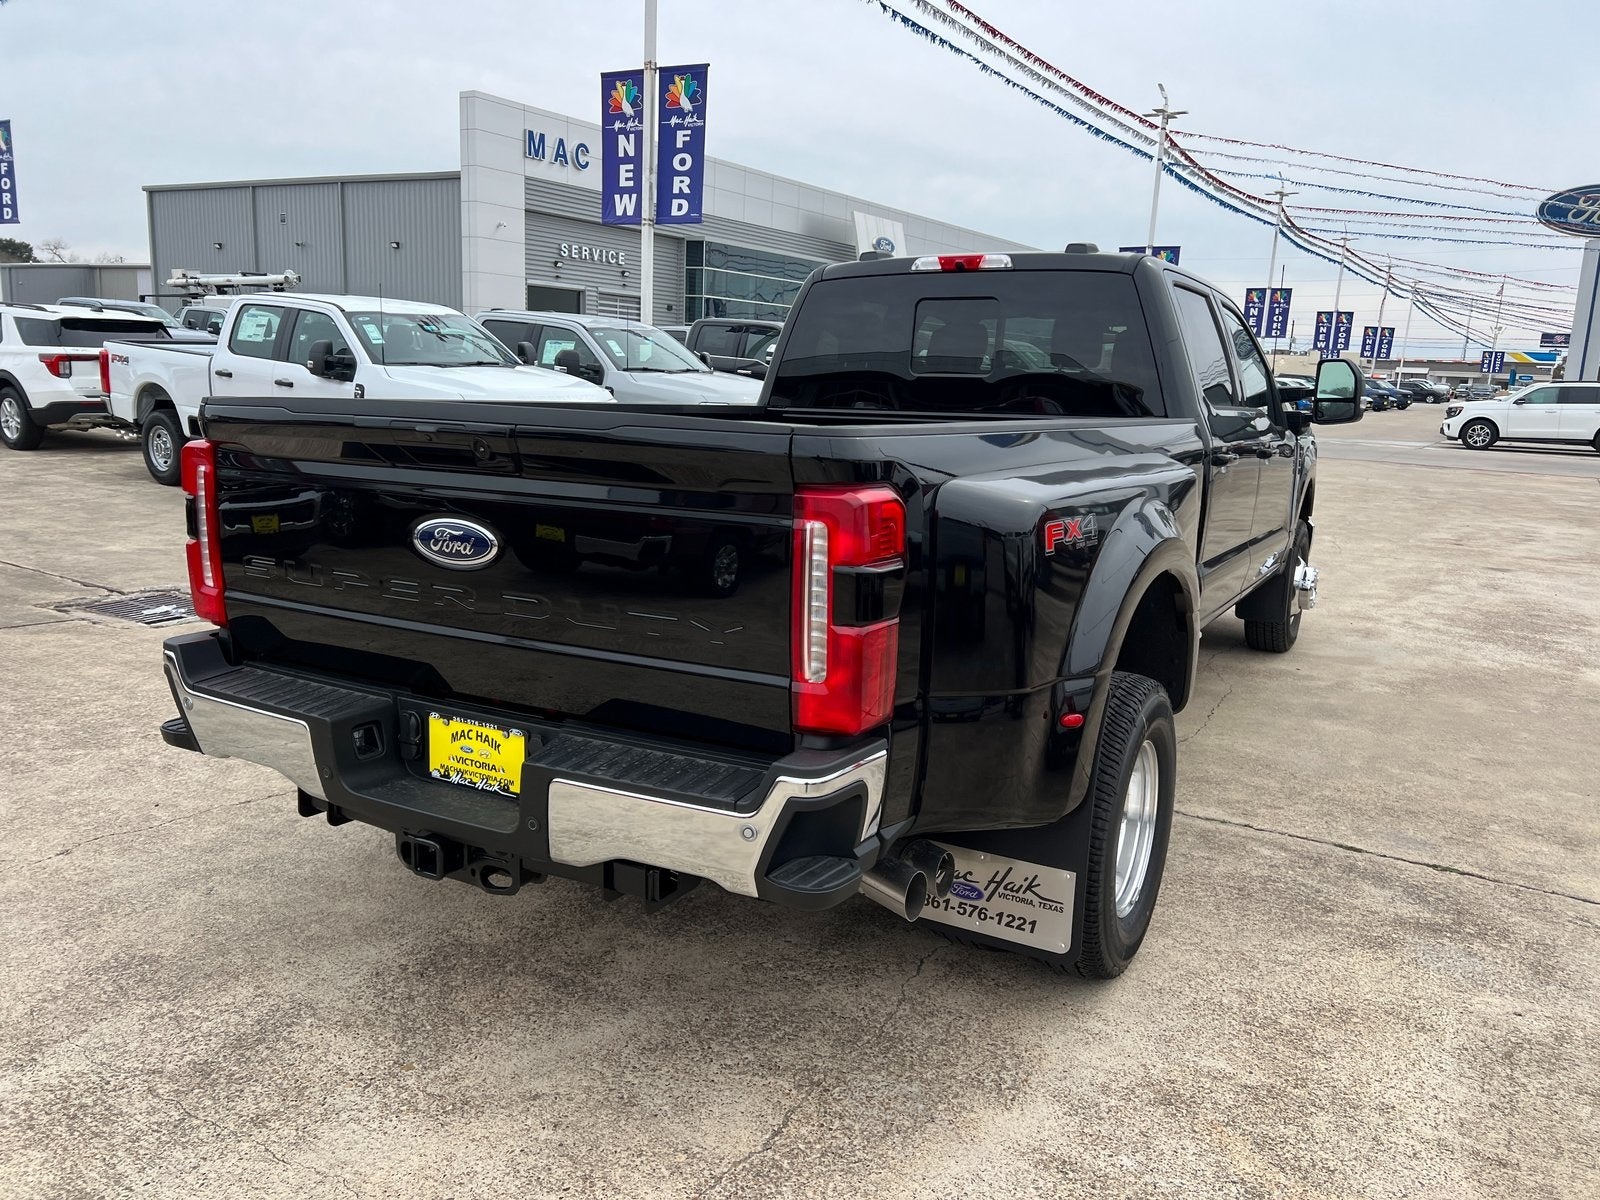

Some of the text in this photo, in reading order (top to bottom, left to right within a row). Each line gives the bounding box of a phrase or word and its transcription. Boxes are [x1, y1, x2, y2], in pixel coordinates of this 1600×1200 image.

[525, 129, 590, 170] MAC
[614, 134, 637, 216] NEW
[671, 130, 692, 217] FORD
[1, 163, 12, 219] FORD
[560, 243, 625, 265] SERVICE
[1317, 327, 1327, 348] NEW
[1337, 327, 1346, 348] FORD
[1364, 339, 1372, 357] NEW
[1380, 340, 1388, 357] FORD
[430, 527, 475, 555] Ford
[1045, 513, 1098, 555] FX4
[242, 555, 745, 645] SUPER DUTY
[451, 729, 501, 754] MAC HAIK
[455, 755, 497, 773] VICTORIA
[449, 772, 508, 796] Mac Haik
[951, 884, 978, 898] Ford
[952, 867, 1056, 904] ac Haik
[998, 892, 1064, 914] VICTORIA, TEXAS
